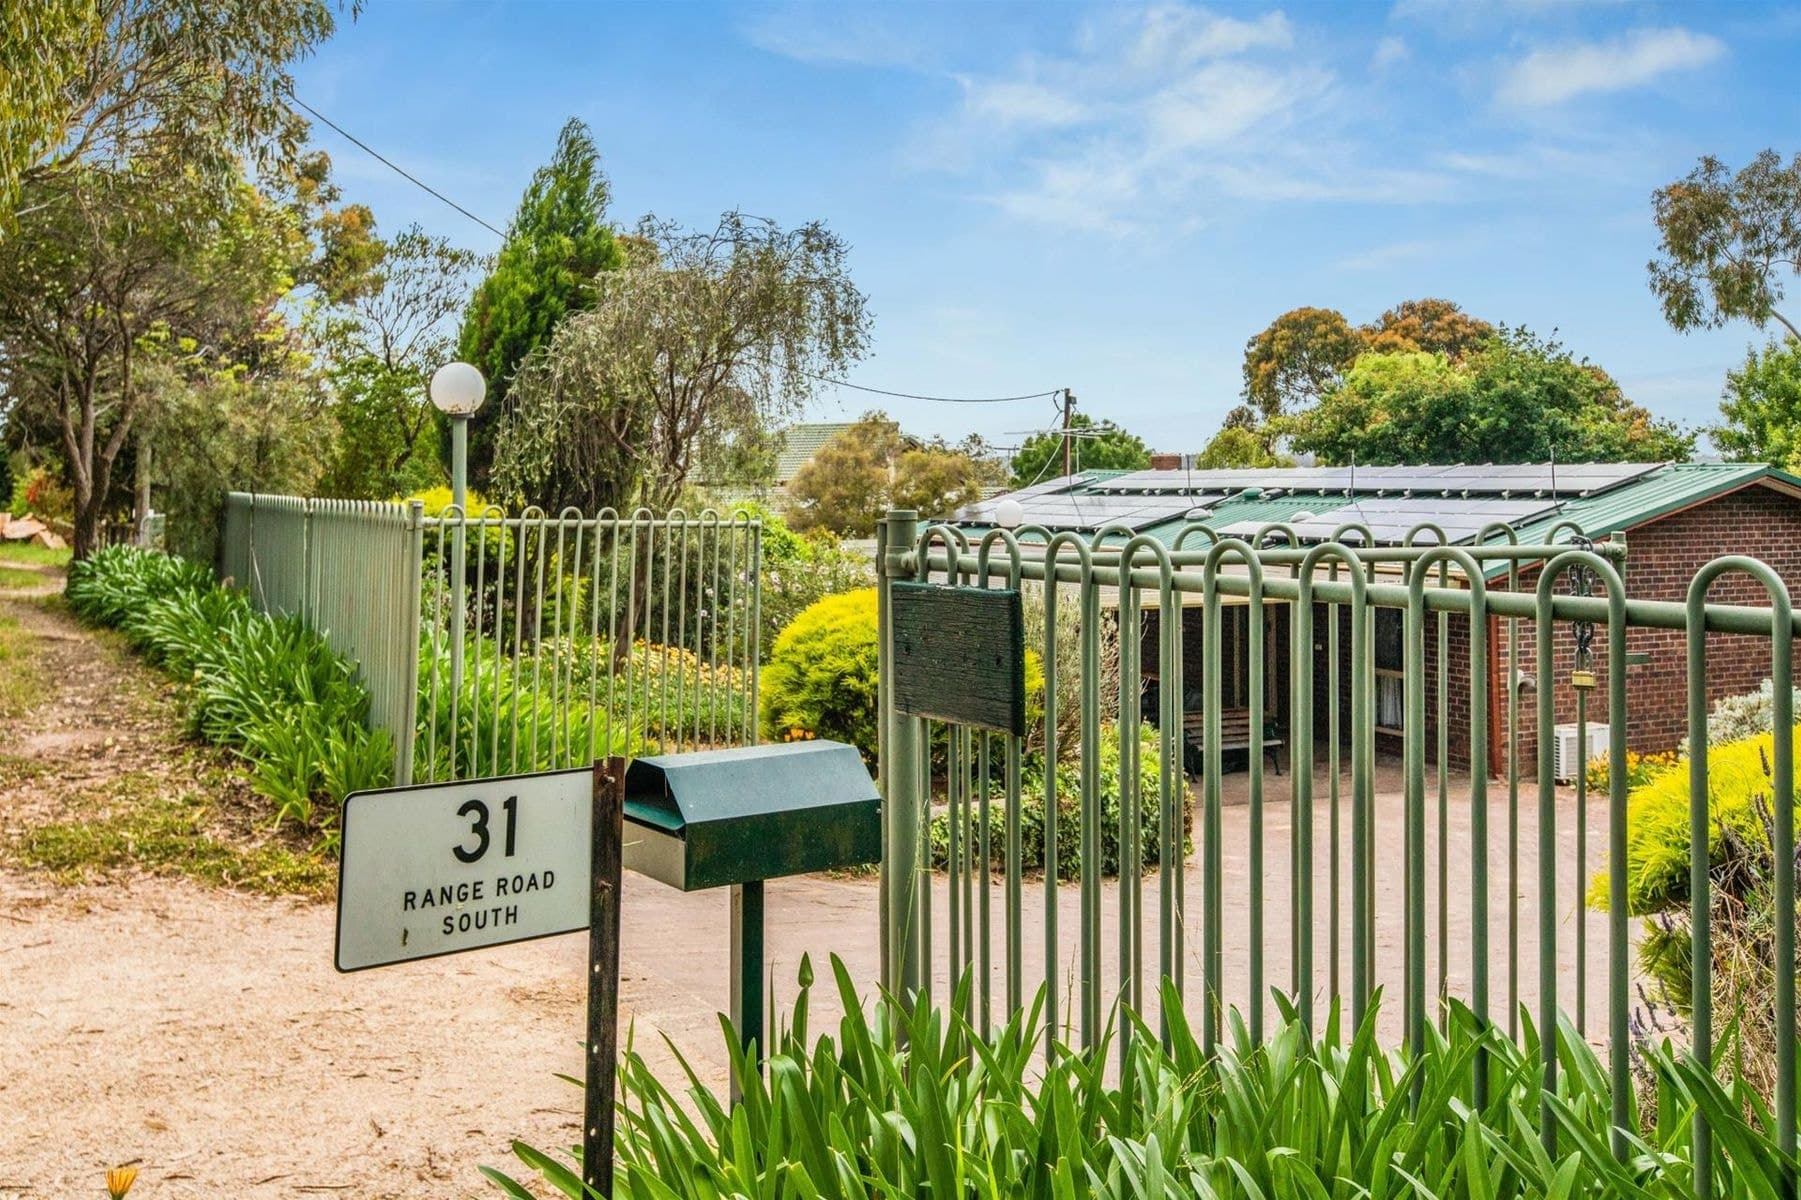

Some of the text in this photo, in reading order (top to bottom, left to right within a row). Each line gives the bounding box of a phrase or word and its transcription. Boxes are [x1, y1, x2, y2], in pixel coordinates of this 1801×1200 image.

[452, 795, 518, 863] 31
[403, 870, 555, 911] RANGE ROAD
[442, 905, 518, 935] SOUTH
